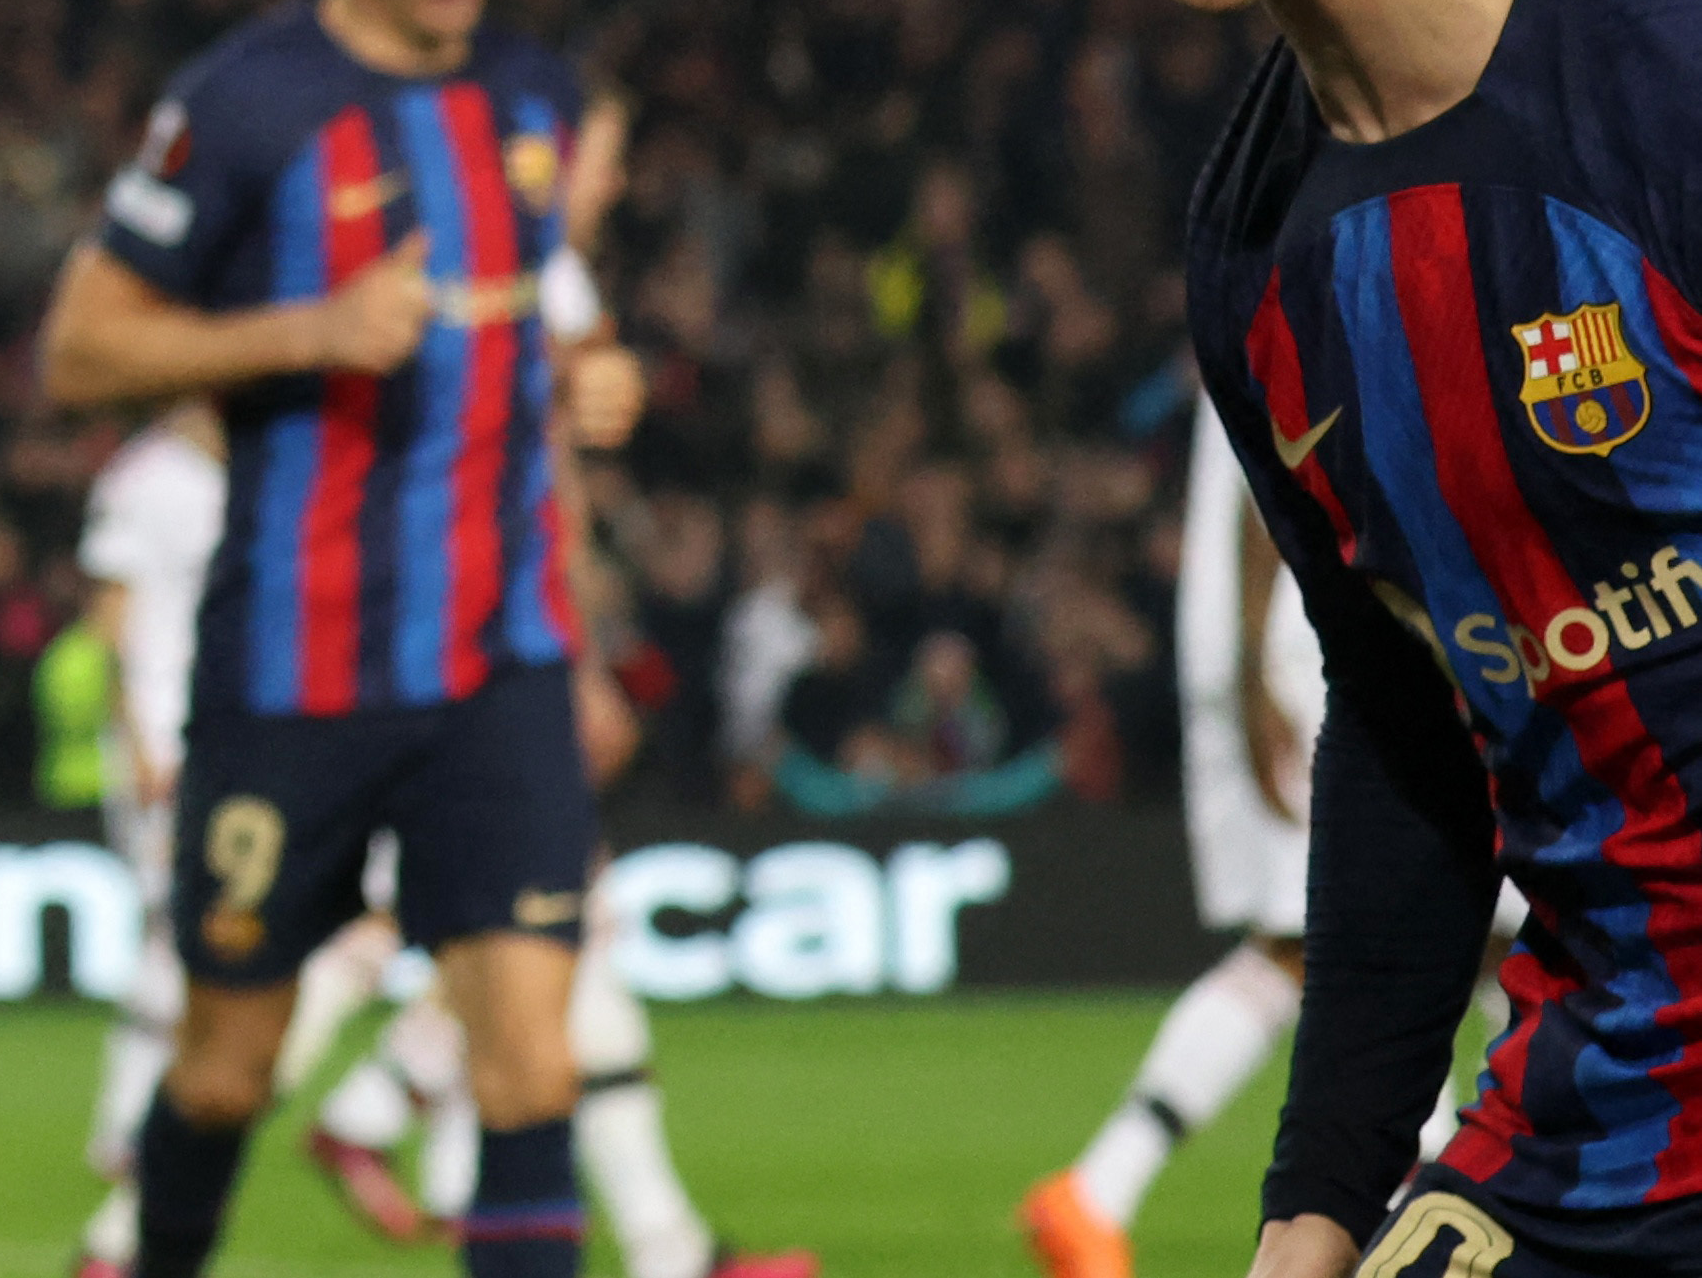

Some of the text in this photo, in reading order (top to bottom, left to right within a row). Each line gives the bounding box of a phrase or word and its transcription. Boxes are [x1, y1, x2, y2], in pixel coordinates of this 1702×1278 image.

[1557, 368, 1604, 394] FCB
[205, 796, 285, 912] 9
[603, 841, 1007, 1001] car
